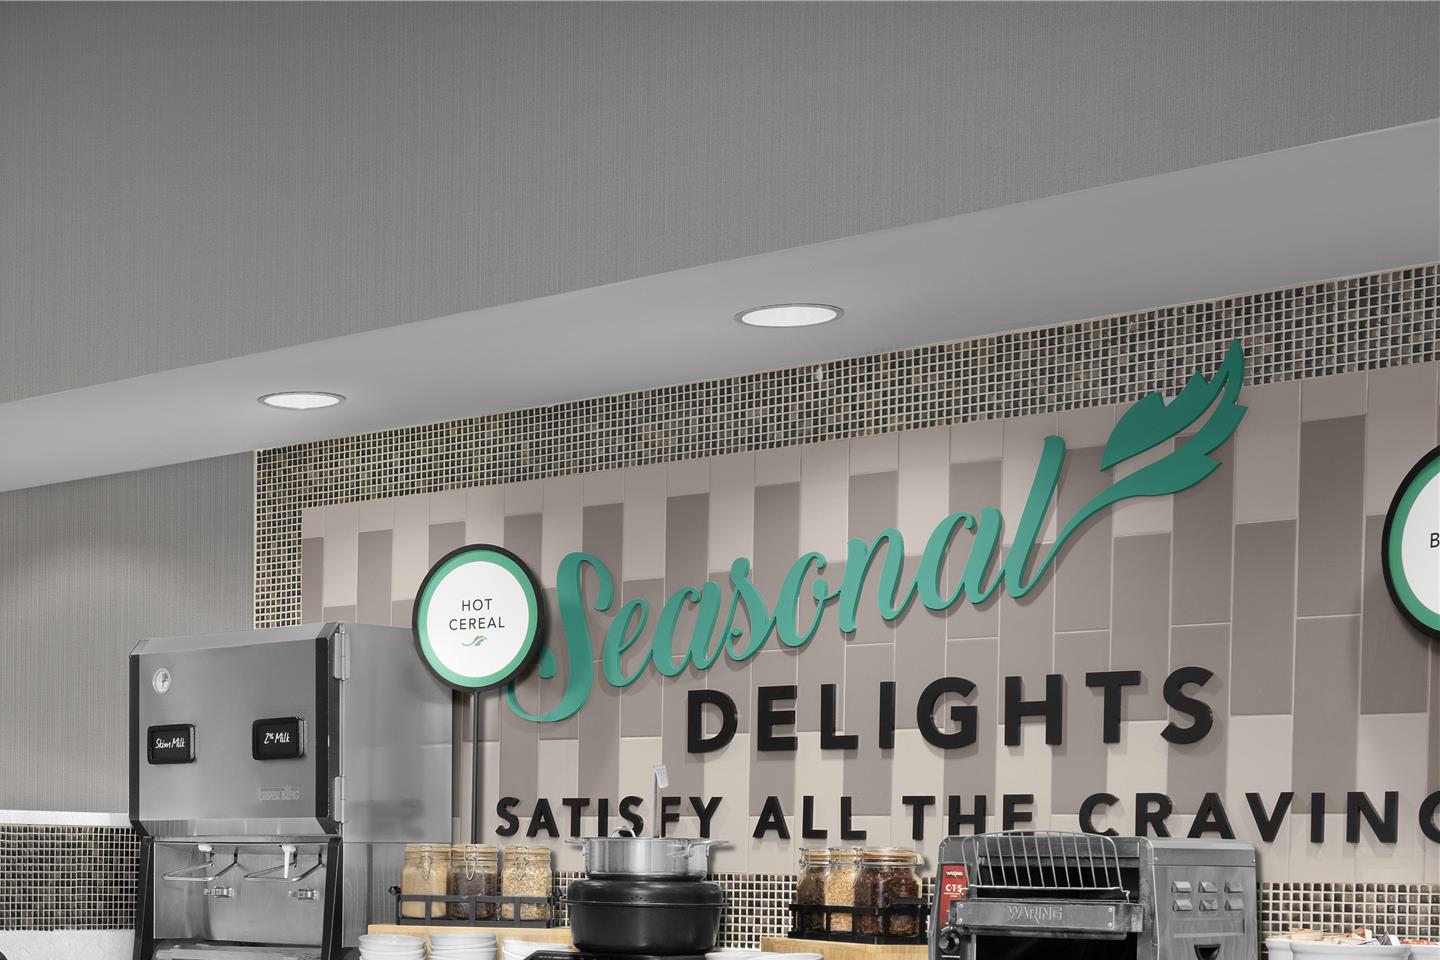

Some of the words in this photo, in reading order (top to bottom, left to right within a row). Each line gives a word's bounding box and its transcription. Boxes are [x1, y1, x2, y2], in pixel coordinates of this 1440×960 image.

[505, 434, 1105, 723] Seasonal
[461, 598, 493, 612] HOT
[448, 616, 505, 631] CEREAL
[686, 665, 1216, 754] DELIGHTS
[155, 738, 171, 749] Skim
[171, 737, 186, 748] Milk
[274, 732, 291, 744] Milk
[495, 795, 723, 838] SATISFY
[752, 795, 867, 840] ALL
[902, 793, 1034, 841] THE
[1008, 905, 1063, 925] WARING
